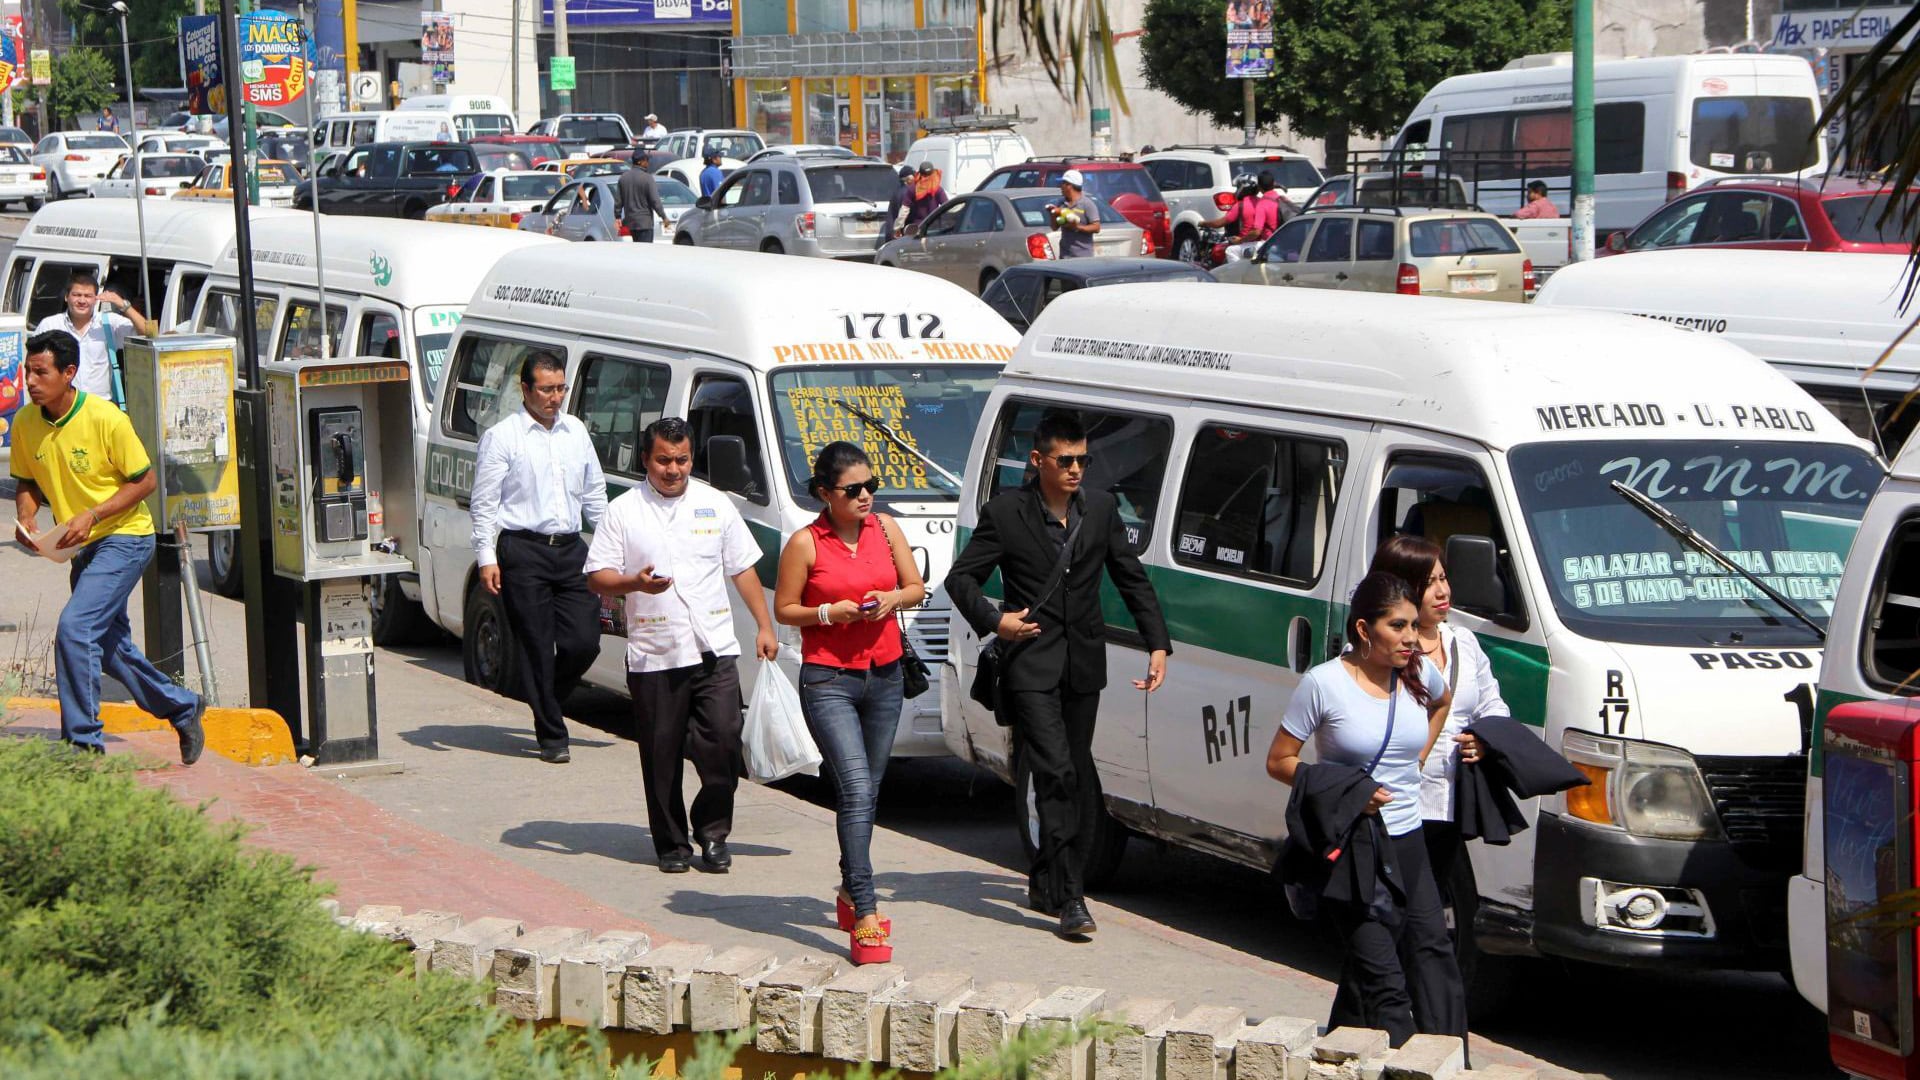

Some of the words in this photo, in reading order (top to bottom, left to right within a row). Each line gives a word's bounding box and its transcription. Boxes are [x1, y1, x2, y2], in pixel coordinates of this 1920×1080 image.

[702, 0, 732, 11] Ba
[1813, 17, 1892, 40] PAPELERIA
[255, 43, 300, 53] DOMINGOS
[250, 88, 282, 101] SMS
[469, 100, 492, 110] 9006
[839, 312, 946, 340] 1712
[772, 343, 864, 364] PATRIA
[867, 342, 904, 360] NVA.
[920, 342, 1018, 363] MERCAD
[788, 386, 823, 399] CERRO
[825, 386, 839, 398] DE
[841, 385, 903, 398] GUADALUPE
[1536, 403, 1666, 431] MERCADO
[1694, 404, 1724, 428] U.
[1731, 405, 1816, 432] PABLO
[800, 431, 860, 443] SEGURO
[863, 430, 917, 442] SOCAL
[1574, 584, 1591, 608] 5
[1594, 582, 1624, 607] DE
[1689, 652, 1814, 670] PASO
[1606, 669, 1625, 697] R
[1202, 694, 1251, 764] R-17
[1598, 704, 1630, 735] 17
[1783, 682, 1818, 755] 1
